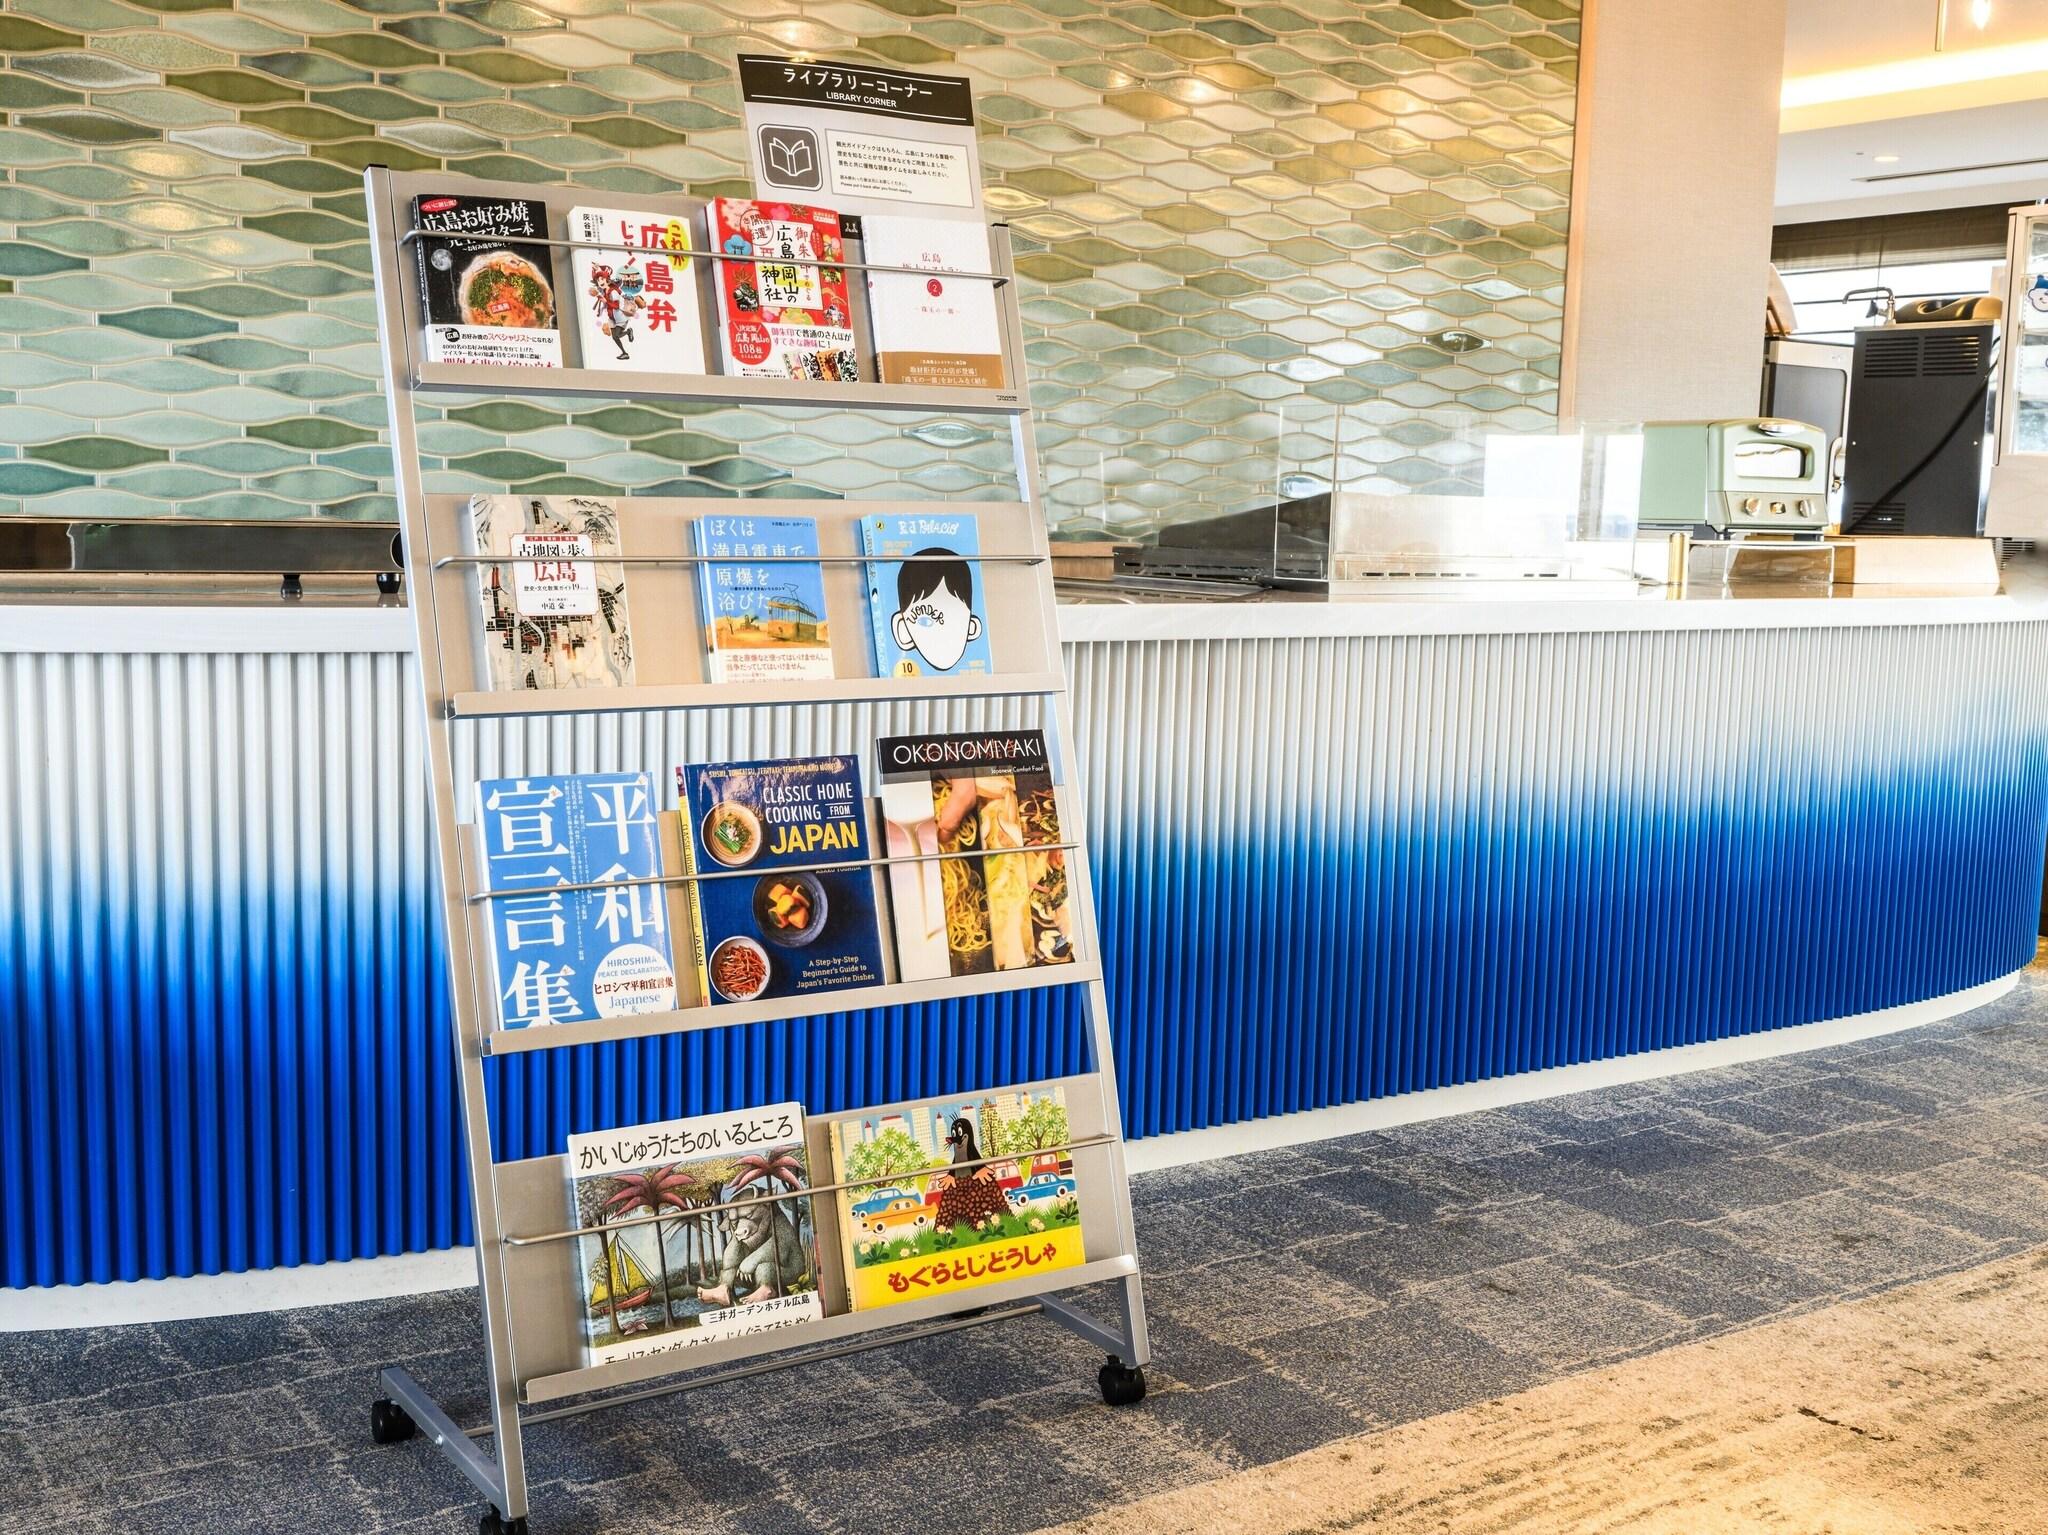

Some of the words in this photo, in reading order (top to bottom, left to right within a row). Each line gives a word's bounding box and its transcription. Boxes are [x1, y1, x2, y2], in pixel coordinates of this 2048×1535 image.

[783, 67, 933, 98] ライブラリーコーナー
[826, 91, 862, 104] LIBRARY
[864, 96, 897, 108] CORNER
[423, 201, 530, 232] 広島お好み焼
[671, 224, 685, 266] これが
[922, 252, 941, 263] 広島
[641, 224, 677, 332] 広島弁
[761, 265, 782, 302] 神社
[710, 519, 755, 537] ぼくは
[712, 543, 806, 557] 満員電車で
[534, 560, 576, 582] 広島
[716, 568, 769, 586] 原爆を
[718, 592, 771, 611] 浴びた
[903, 663, 913, 673] 10
[893, 738, 1042, 765] OKONOMIYAKI
[1012, 765, 1031, 773] Comfort
[763, 785, 812, 804] CLASSIC
[817, 782, 853, 800] HOME
[765, 805, 821, 824] COOKING
[829, 805, 850, 816] FROM
[770, 821, 859, 855] JAPAN
[586, 774, 665, 944] 平和
[486, 780, 584, 1026] 宣言集
[695, 934, 704, 966] JAPAN
[607, 956, 657, 967] HIROSHIMA
[815, 956, 859, 967] Step-by-Step
[598, 970, 618, 978] PEACE
[621, 966, 668, 976] DECLARATIONS
[796, 978, 823, 989] Japan's
[823, 976, 851, 985] Favorite
[852, 973, 875, 982] Dishes
[802, 967, 838, 978] Beginner's
[839, 966, 859, 974] Guide
[595, 976, 674, 995] ヒロシマ平和宣言集
[609, 993, 661, 1008] Japanese
[580, 1115, 794, 1170] かいじゅうたちのいるところ
[888, 1242, 1057, 1293] もぐらとじどうしゃ
[708, 1294, 811, 1324] 三井ガーデンホテル広島
